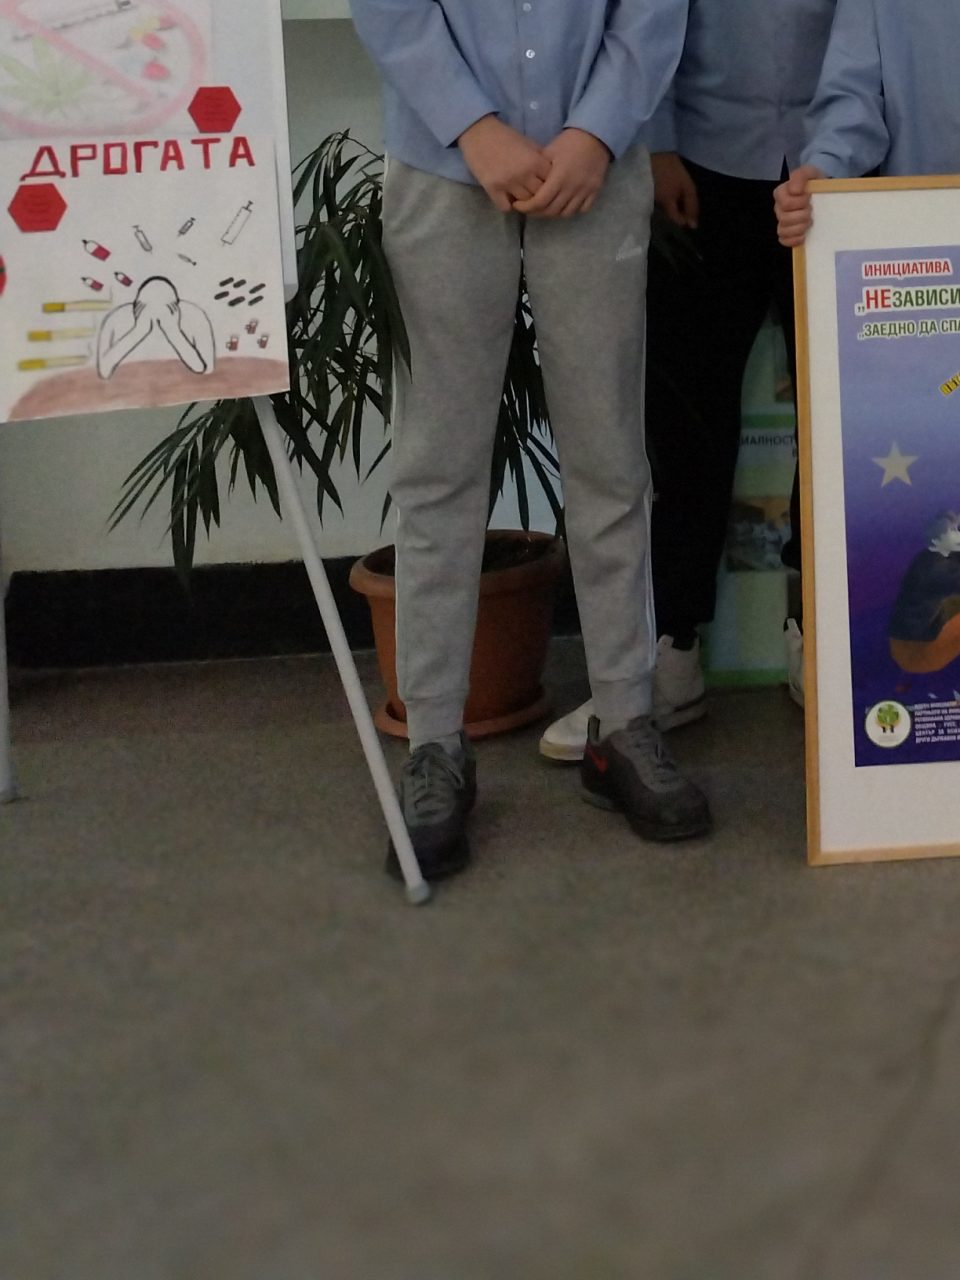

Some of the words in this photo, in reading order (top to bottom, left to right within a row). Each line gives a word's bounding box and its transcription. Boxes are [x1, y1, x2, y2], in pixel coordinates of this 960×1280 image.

[20, 136, 255, 181] ДРОГАТА
[864, 260, 951, 277] ИНИЦИАТИВА
[859, 321, 916, 338] „ЗАЕДНО
[919, 320, 937, 336] ДА
